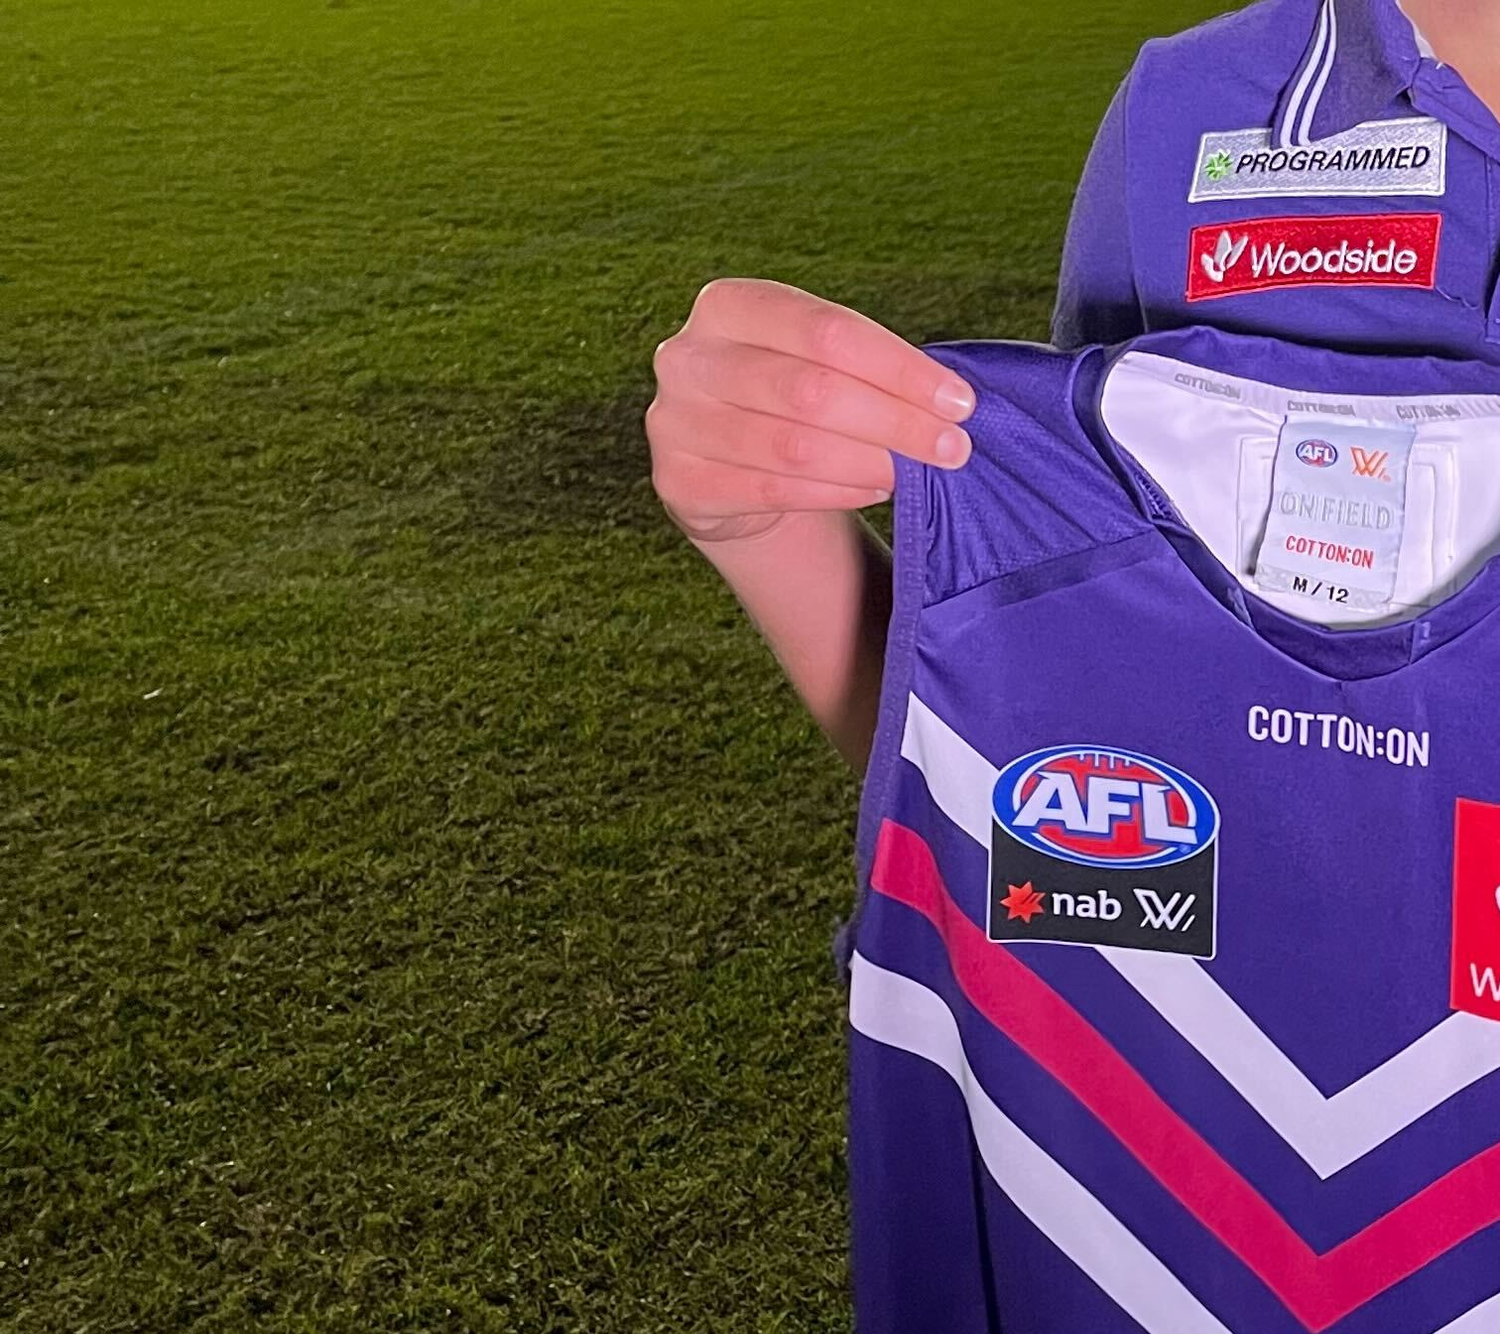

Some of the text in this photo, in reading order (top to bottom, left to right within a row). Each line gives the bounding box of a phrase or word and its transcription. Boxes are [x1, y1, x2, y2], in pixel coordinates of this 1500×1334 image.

[1235, 145, 1431, 175] PROGRAMMED
[1250, 238, 1418, 278] Woodside
[1300, 444, 1334, 463] AFL
[1321, 496, 1392, 531] FIELD
[1285, 535, 1374, 570] COTTON:ON
[1292, 575, 1308, 593] M
[1326, 585, 1350, 604] 12
[1247, 704, 1431, 768] COTTON:ON
[1011, 770, 1198, 845] AFL
[1051, 889, 1123, 921] nab
